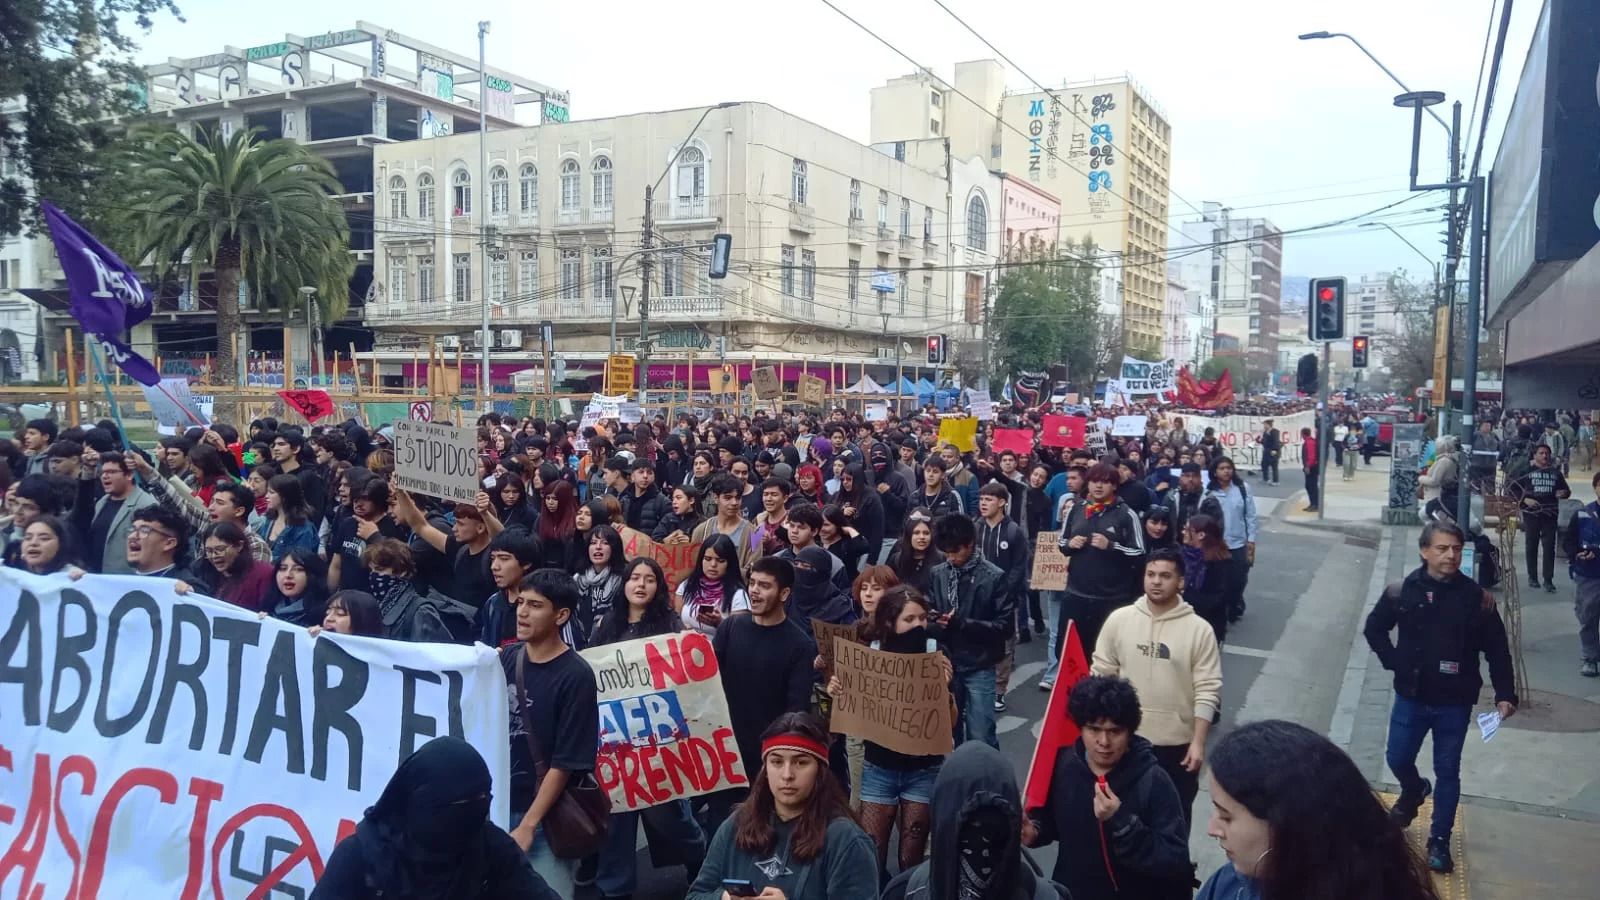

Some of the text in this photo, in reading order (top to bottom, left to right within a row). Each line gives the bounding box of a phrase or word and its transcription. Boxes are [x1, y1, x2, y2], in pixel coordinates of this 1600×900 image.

[450, 431, 459, 440] DE
[443, 485, 452, 497] EL
[596, 632, 719, 693] mbre NO
[836, 640, 850, 665] LA
[921, 655, 941, 679] ES
[0, 588, 369, 792] ABORTAR
[923, 683, 942, 701] NO
